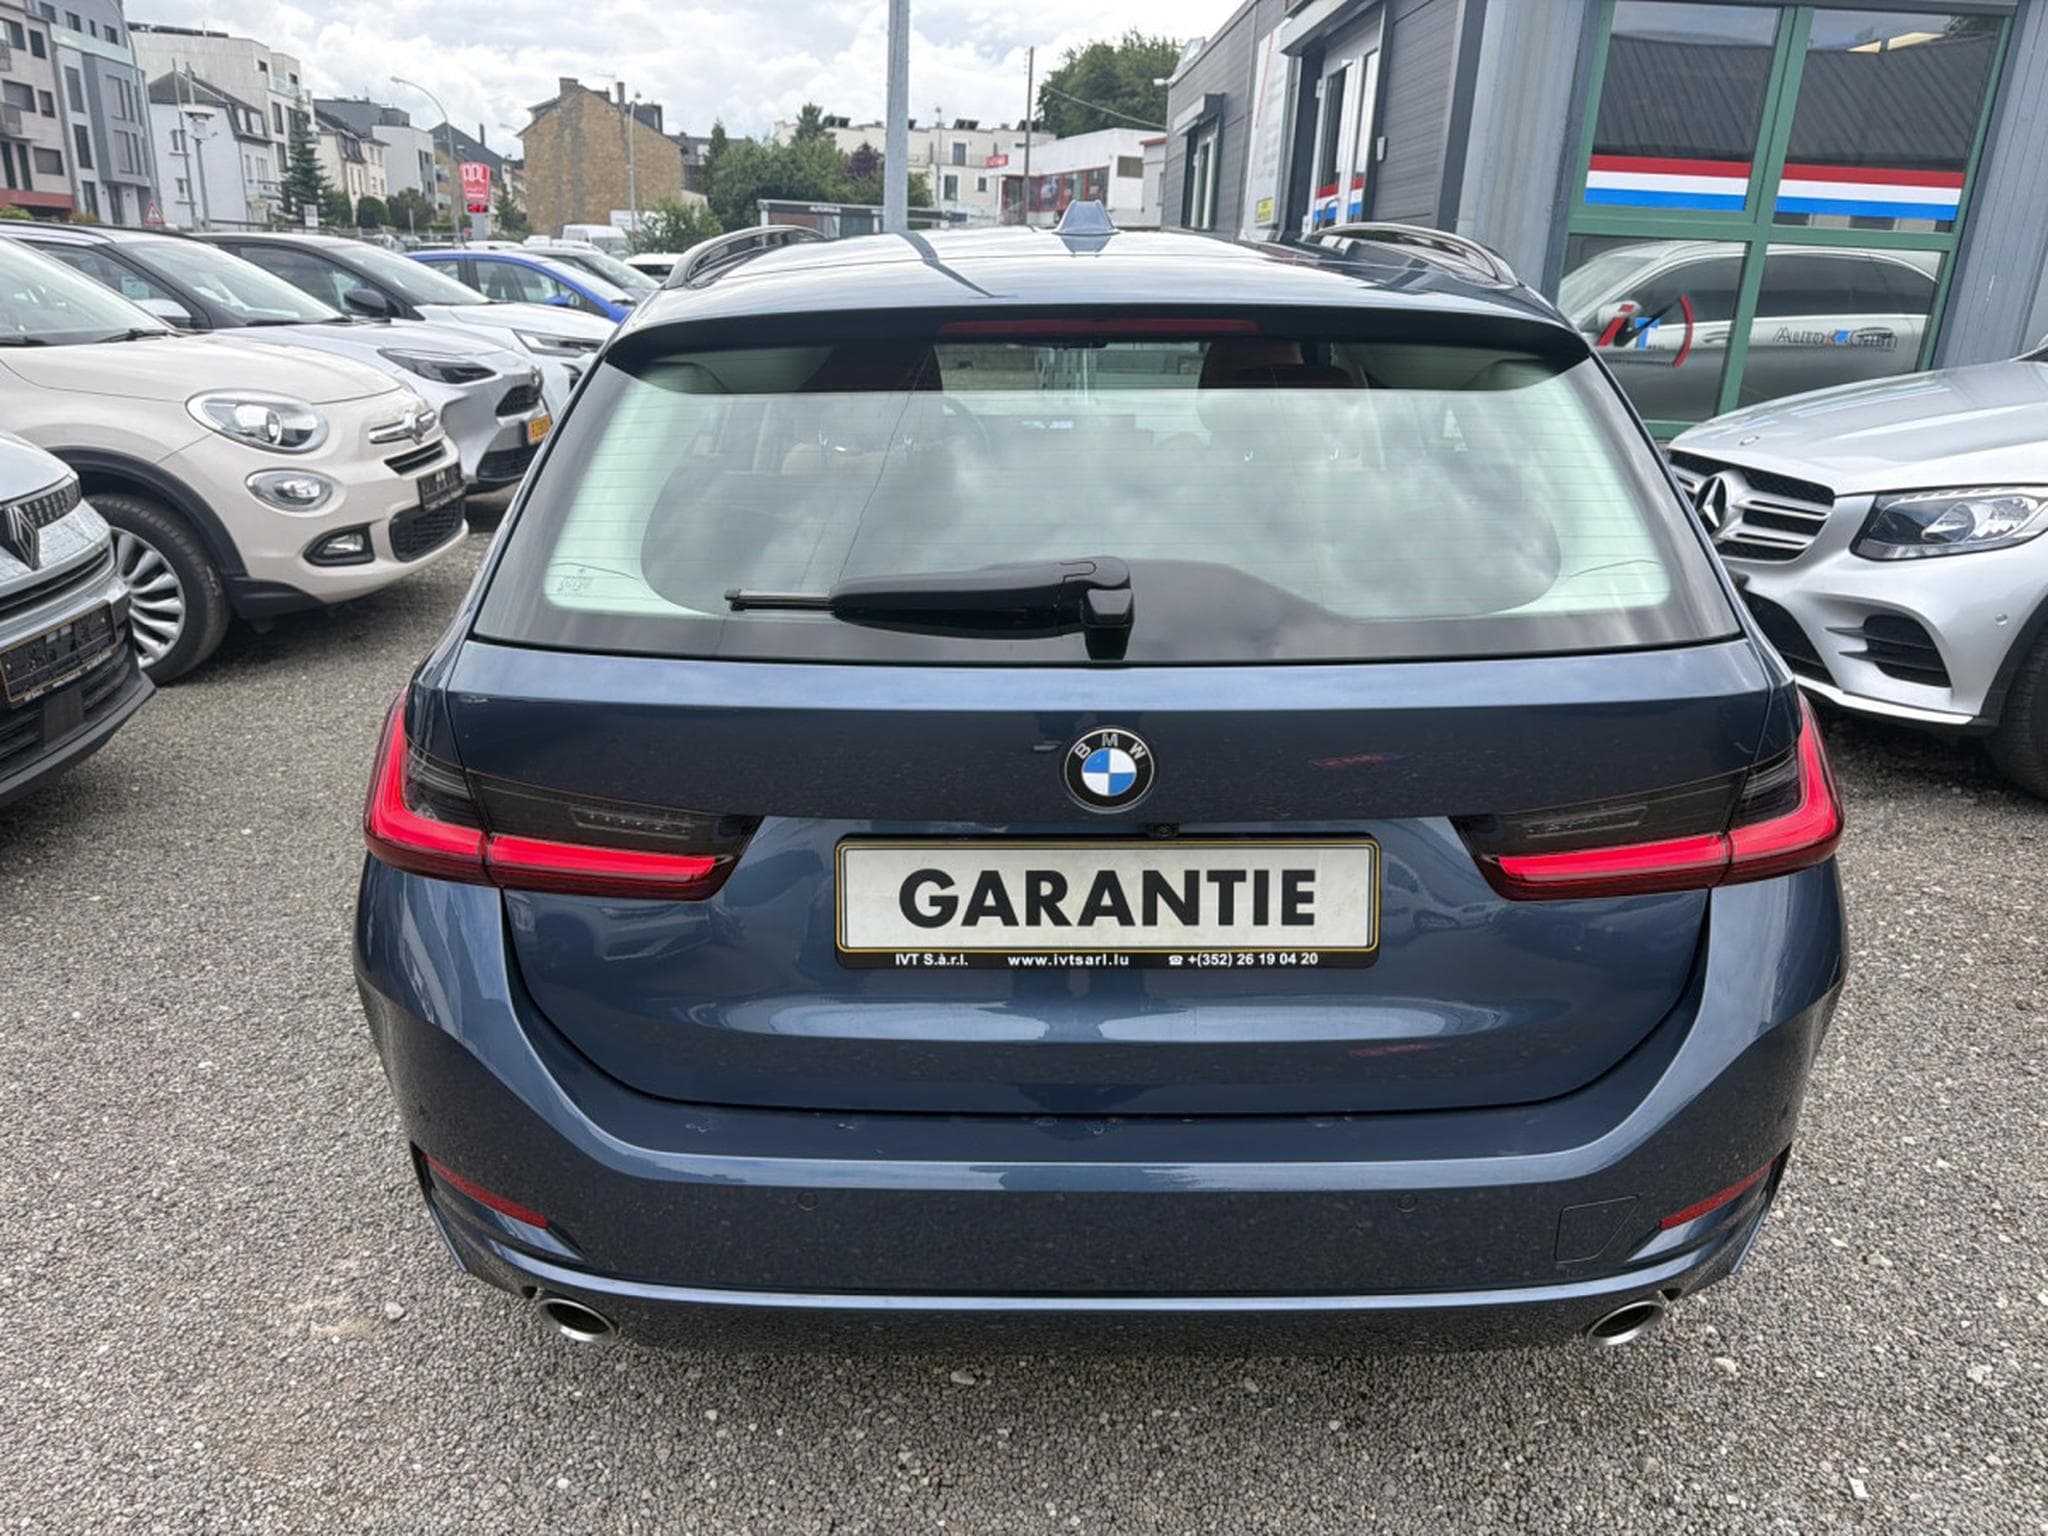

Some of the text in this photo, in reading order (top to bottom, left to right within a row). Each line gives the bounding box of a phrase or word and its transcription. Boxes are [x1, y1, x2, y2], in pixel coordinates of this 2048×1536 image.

[1074, 733, 1146, 760] BMW
[898, 868, 1316, 928] GARANTIE
[895, 953, 969, 966] IVT S.à.r.l.
[1008, 954, 1129, 967] www.ivtsarl.lu
[1187, 952, 1319, 967] +(352) 26 19 04 20
